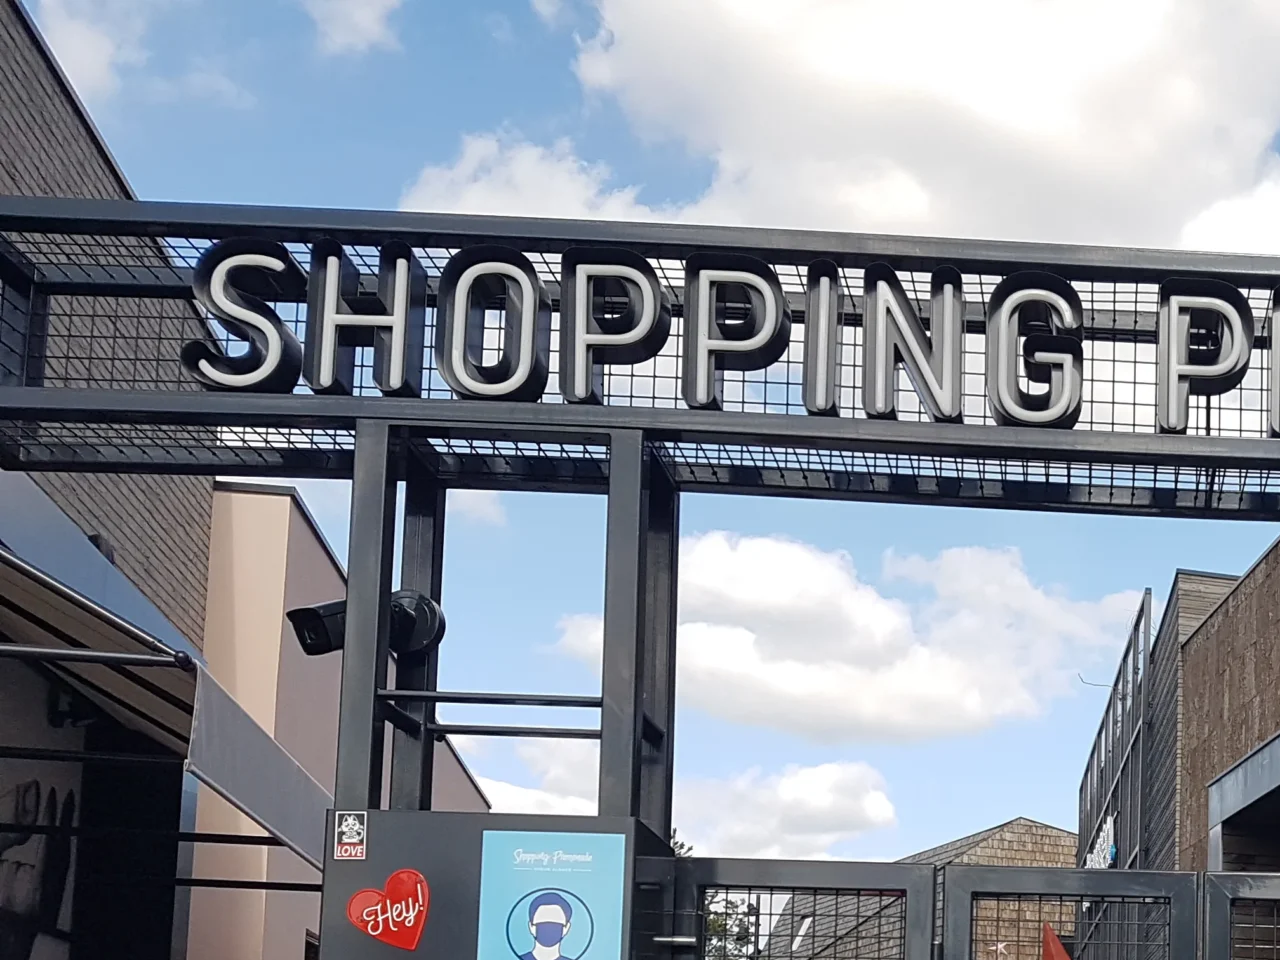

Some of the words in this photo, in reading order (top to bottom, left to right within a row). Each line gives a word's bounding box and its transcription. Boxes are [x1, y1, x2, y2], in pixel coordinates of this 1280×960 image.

[190, 242, 1081, 426] SHOPPING
[337, 845, 364, 857] LOVE
[362, 883, 424, 936] Hey!
